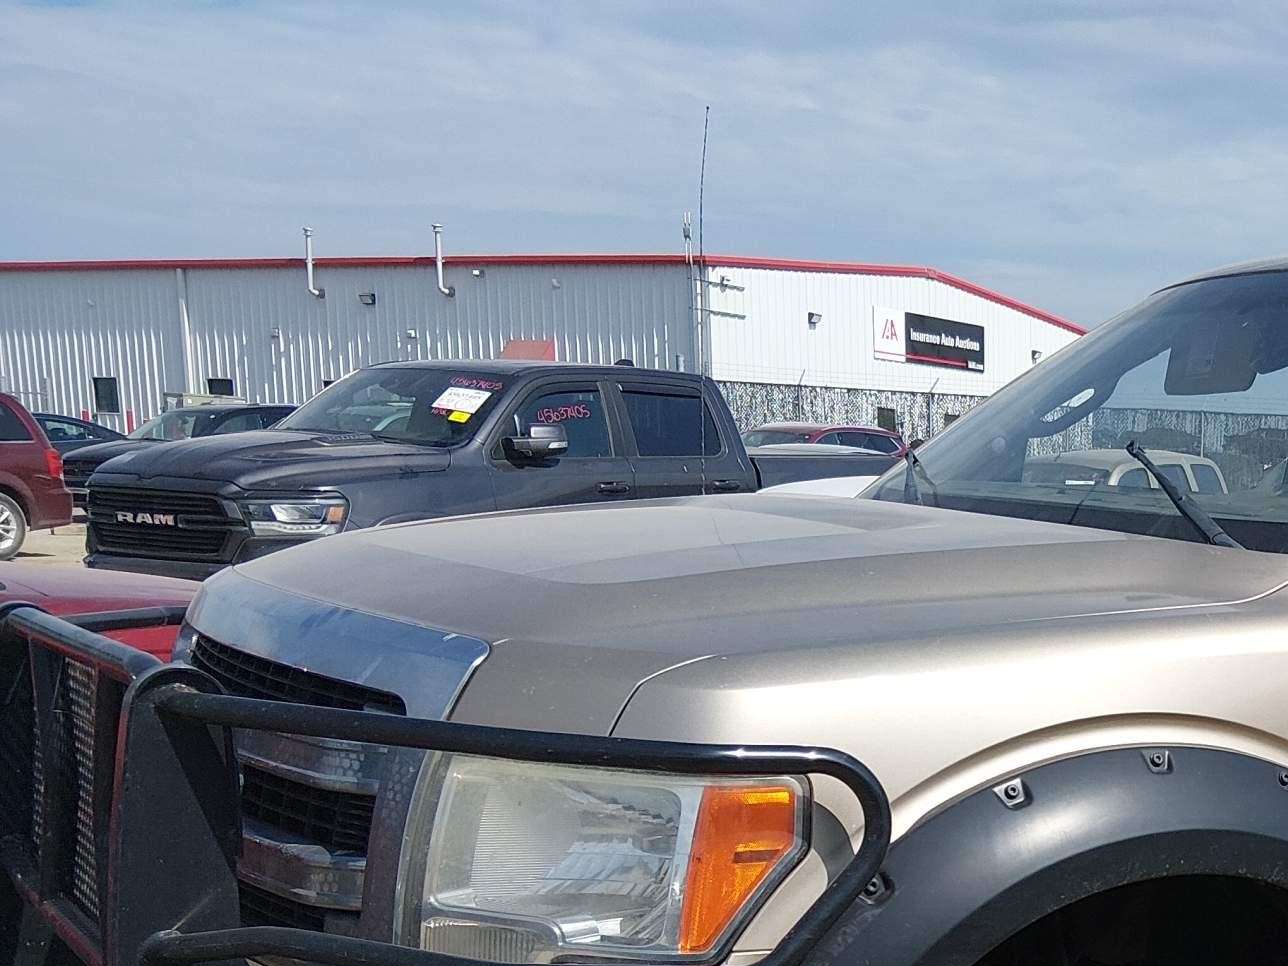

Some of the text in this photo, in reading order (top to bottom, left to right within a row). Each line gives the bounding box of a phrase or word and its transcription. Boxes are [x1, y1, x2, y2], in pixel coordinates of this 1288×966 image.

[910, 328, 980, 352] Insurance Auto Auctions
[537, 404, 591, 424] 45637405
[116, 511, 175, 526] RAM
